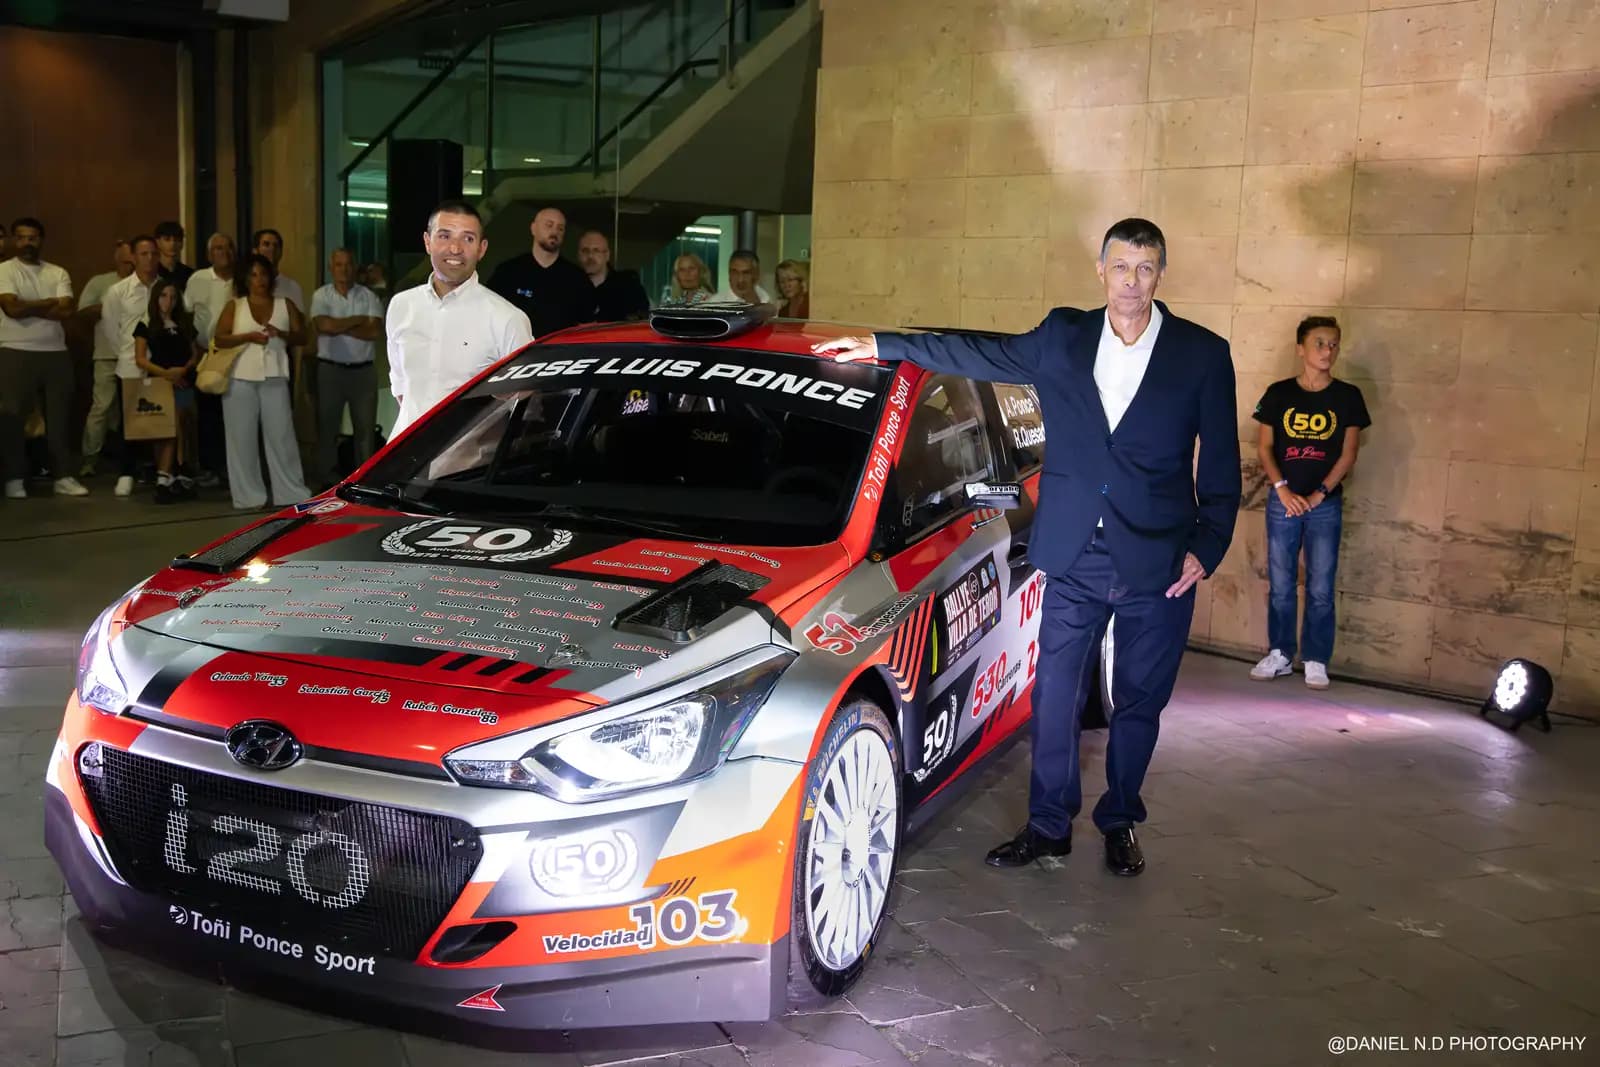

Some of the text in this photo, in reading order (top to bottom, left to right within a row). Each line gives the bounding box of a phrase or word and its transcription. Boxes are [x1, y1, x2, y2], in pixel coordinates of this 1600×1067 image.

[488, 357, 877, 409] JOSE LUIS PONCE
[867, 375, 911, 488] Toñi Ponce Sport
[1293, 413, 1326, 431] 50
[415, 526, 532, 551] 50
[943, 580, 971, 624] RALLYE
[948, 612, 969, 651] VILLA
[968, 603, 979, 633] DE
[210, 671, 251, 682] Orlando
[298, 684, 351, 695] Sebastián
[972, 650, 1006, 719] 530
[402, 699, 439, 712] Rubén
[818, 711, 858, 784] MICHELIN
[923, 710, 948, 764] 50
[164, 782, 370, 909] i20
[555, 840, 618, 877] 50
[190, 909, 376, 975] Toñi Ponce Sport
[543, 888, 738, 953] Velocidad 103
